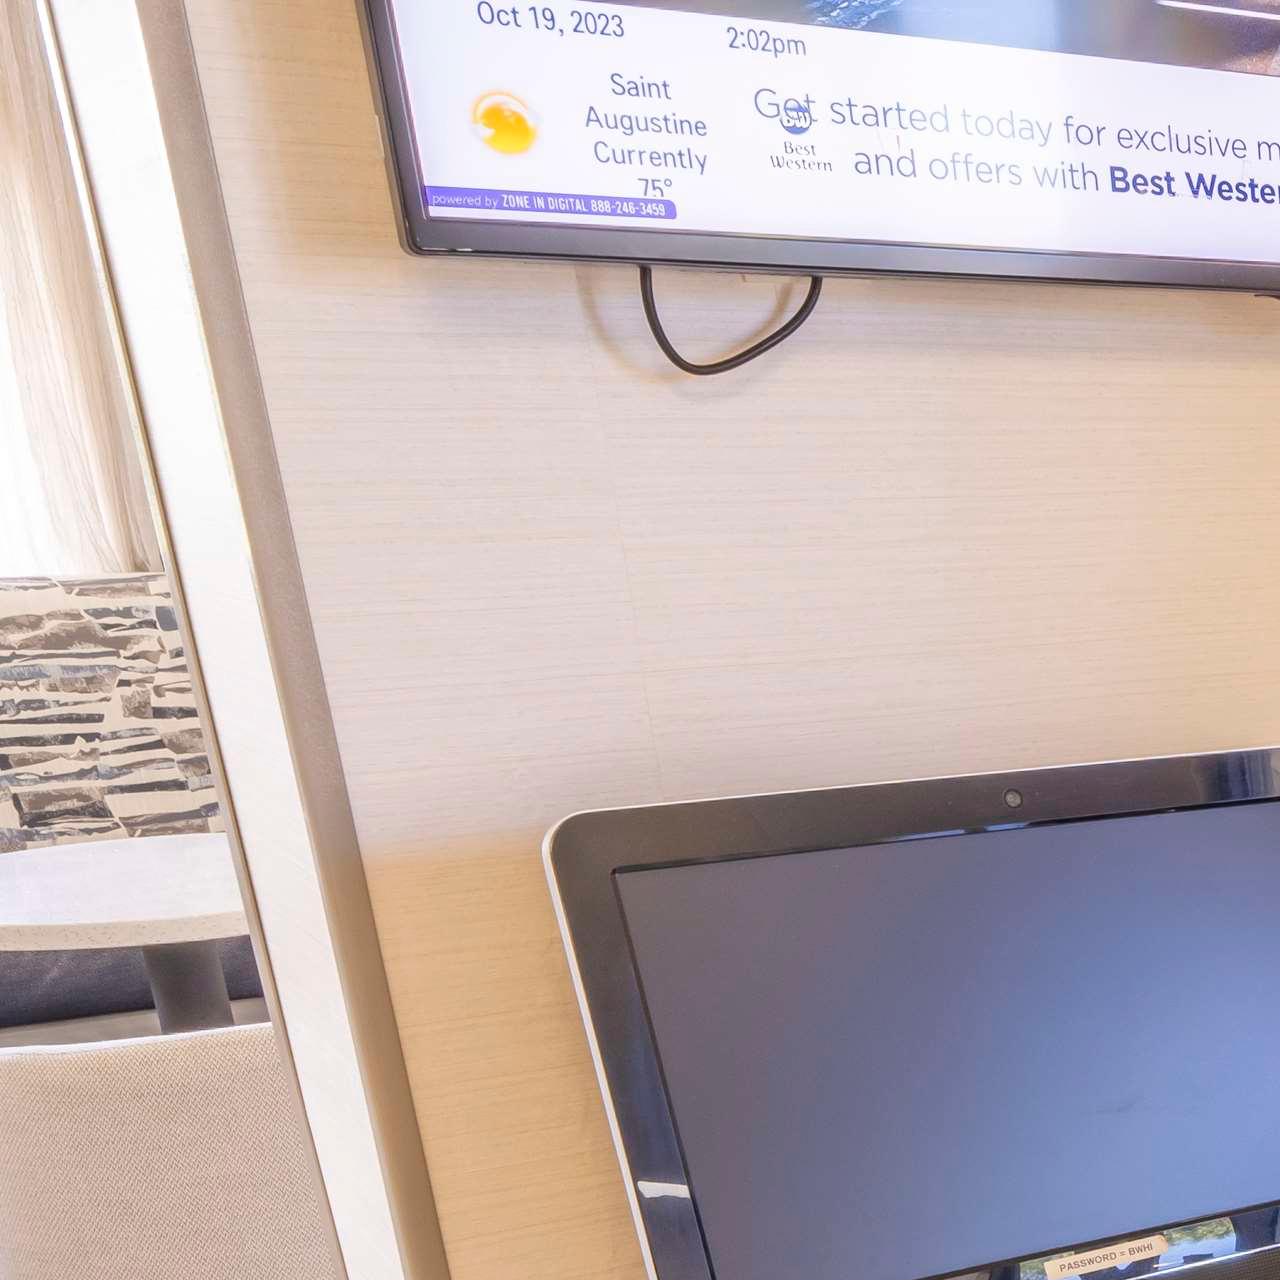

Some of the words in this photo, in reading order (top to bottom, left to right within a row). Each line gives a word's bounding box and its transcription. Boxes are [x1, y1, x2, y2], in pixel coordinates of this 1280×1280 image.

[477, 2, 518, 29] Oct
[525, 5, 566, 38] 19,
[572, 11, 624, 38] 2023
[727, 28, 806, 58] 2:02pm
[610, 73, 672, 100] Saint
[585, 106, 708, 138] Augustine
[830, 100, 949, 134] started
[961, 109, 1053, 149] today
[1062, 114, 1105, 148] for
[1117, 124, 1248, 160] exclusive
[594, 141, 707, 174] Currently
[769, 156, 832, 172] Western
[783, 141, 818, 156] Best
[854, 149, 916, 178] and
[928, 153, 1021, 186] offers
[1031, 161, 1100, 192] with
[1110, 166, 1176, 197] Best
[432, 194, 482, 209] powered
[484, 198, 498, 209] by
[502, 195, 528, 209] ZONE
[532, 197, 544, 210] IN
[548, 198, 588, 212] DIGITAL
[1060, 1252, 1116, 1273] PASSWORD
[1128, 1242, 1153, 1256] BWHI
